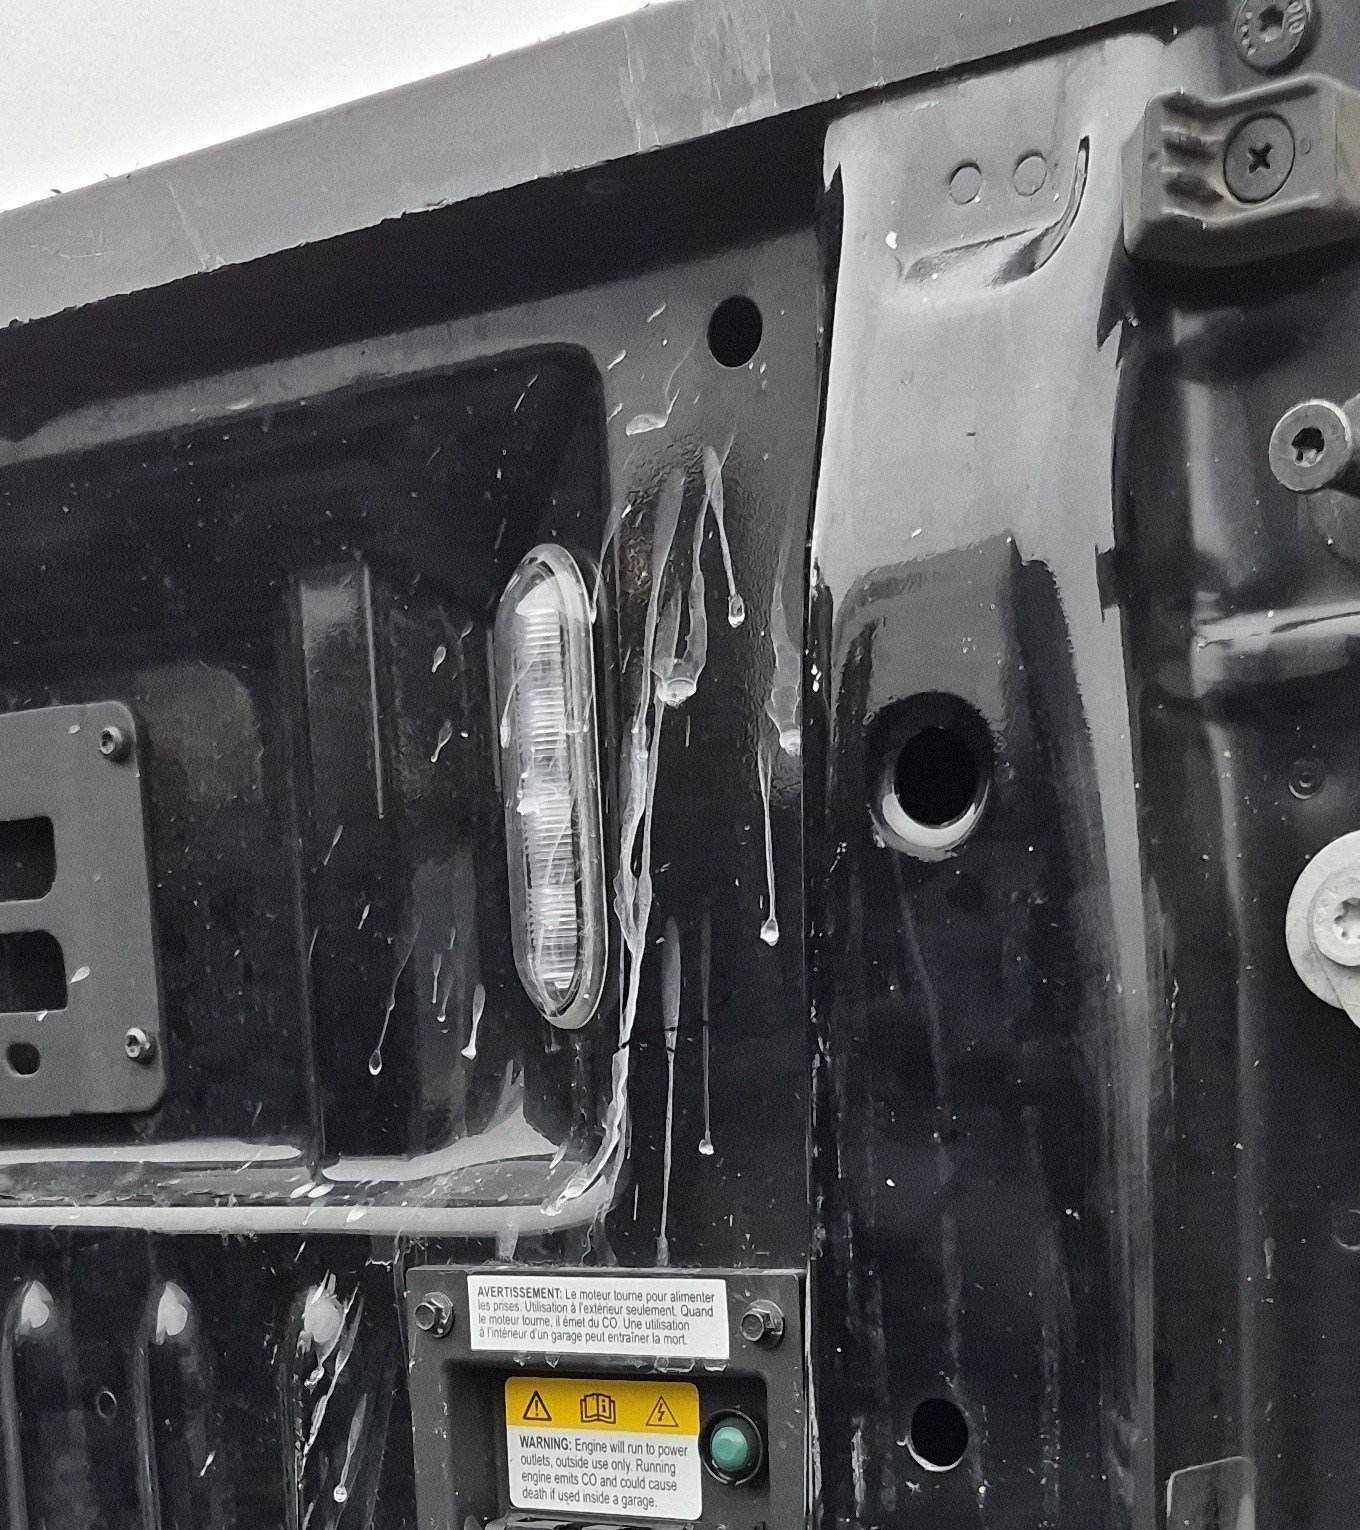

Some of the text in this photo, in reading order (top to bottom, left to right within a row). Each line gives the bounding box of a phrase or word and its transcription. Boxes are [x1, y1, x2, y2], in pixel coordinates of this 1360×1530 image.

[478, 1286, 715, 1304] AVERTISSEMENT: Le moteur tourne pour alimenter
[478, 1299, 714, 1317] les prises. Utilisation à l'extérieur seulement. Quand
[478, 1313, 690, 1331] le moteur tourne, il émet du CO. Une utilisation
[479, 1326, 688, 1345] à l'intérieur d'un garage peut entraîner la mort.
[519, 1435, 688, 1458] WARNING: Engine will run to power
[520, 1453, 676, 1477] outlets, outside use only. Running
[521, 1471, 677, 1491] engine emits CO and could cause
[522, 1486, 658, 1510] death if used inside a garage.
